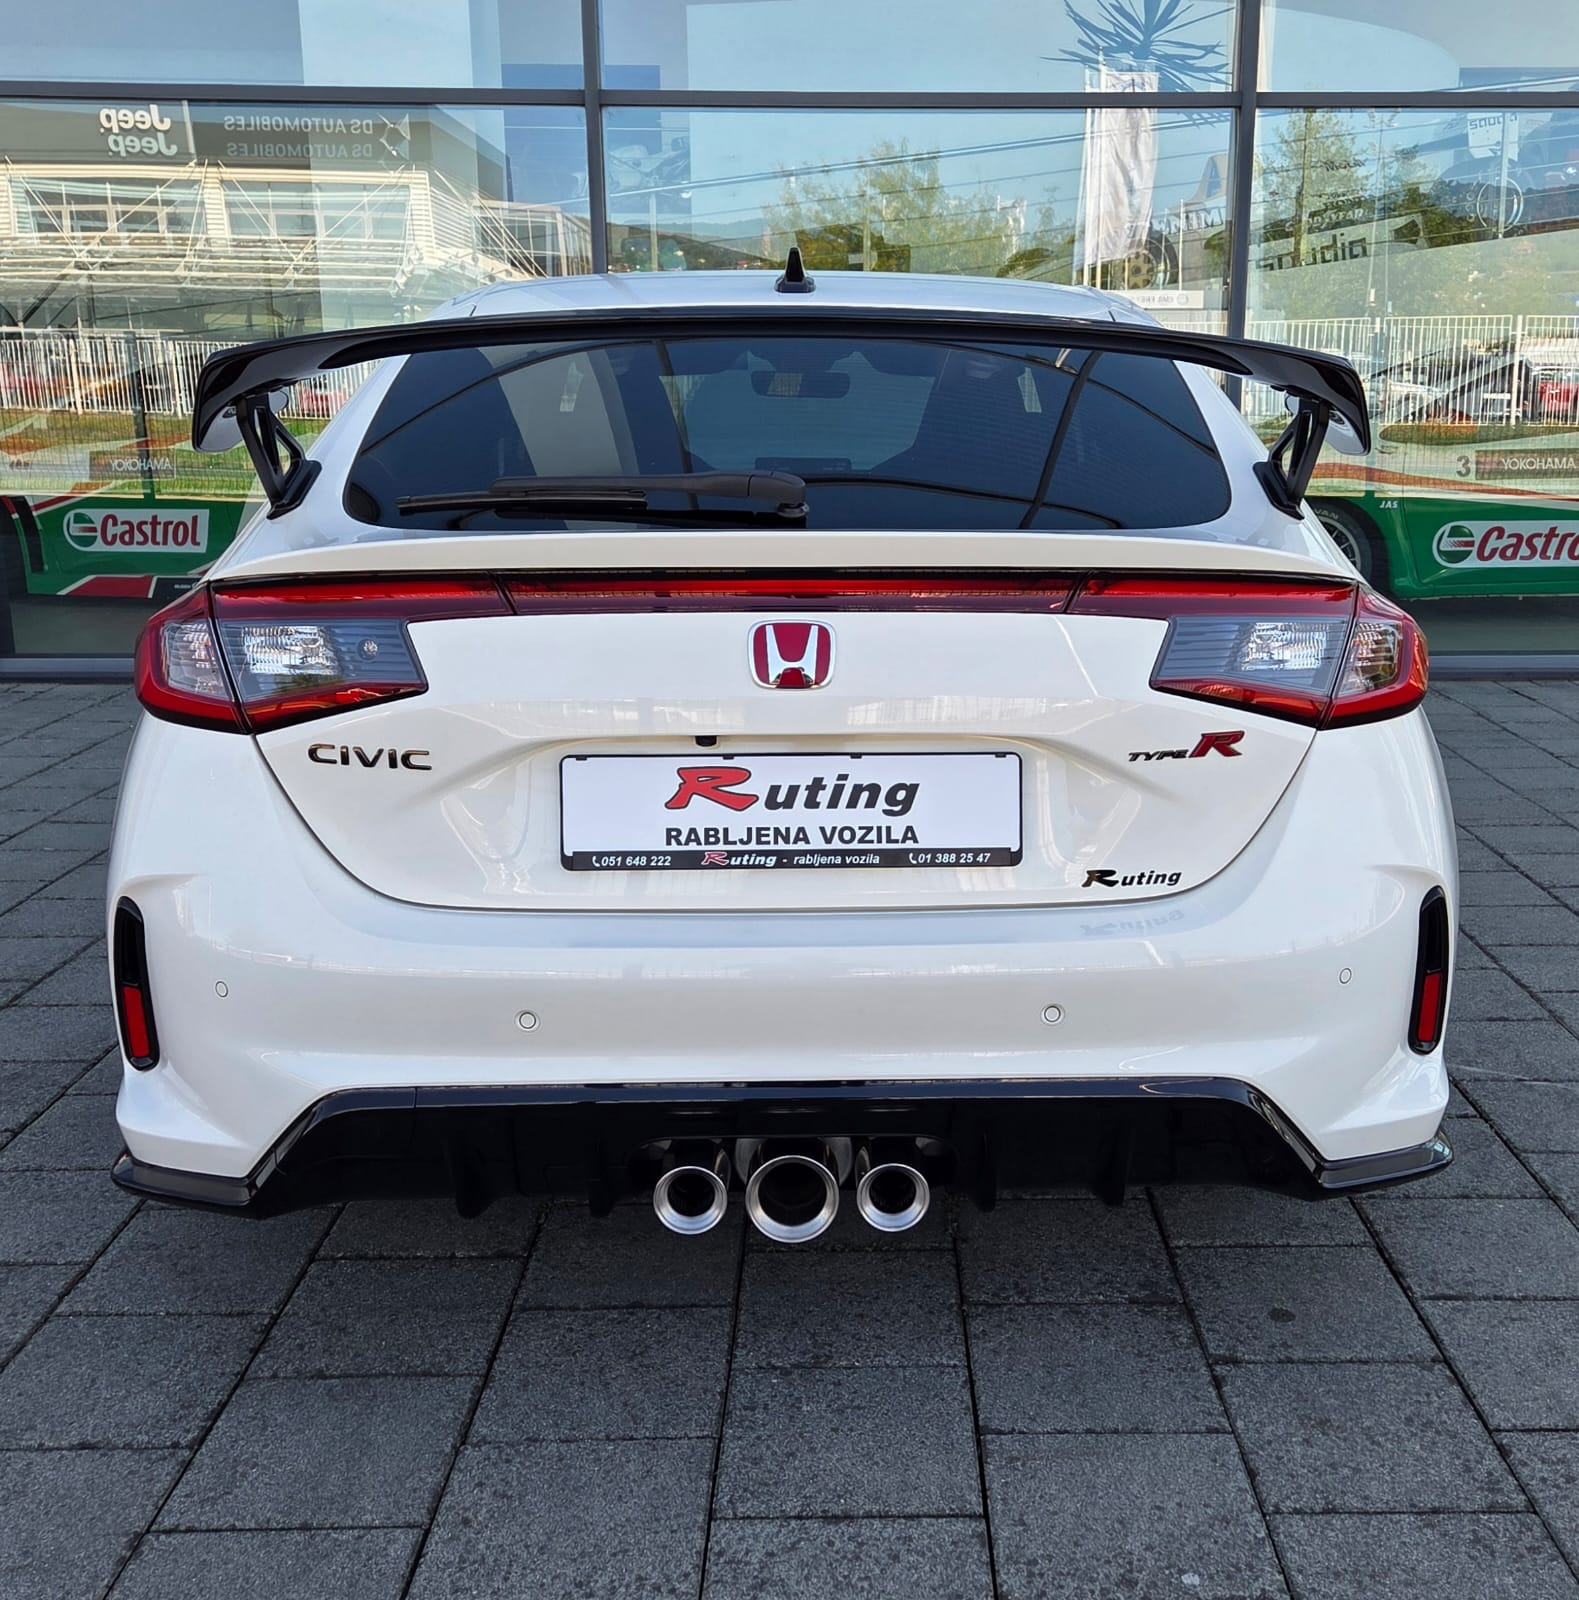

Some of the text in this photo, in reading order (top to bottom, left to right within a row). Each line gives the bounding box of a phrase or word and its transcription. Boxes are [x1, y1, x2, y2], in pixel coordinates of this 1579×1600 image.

[1456, 456, 1471, 477] 3
[1503, 457, 1577, 470] YOKOHAMA
[101, 514, 200, 546] Castrol
[1128, 730, 1245, 762] TYPE R
[308, 743, 433, 771] CIVIC
[665, 766, 920, 817] Ruting
[665, 825, 919, 846] RABLJENA VOZILA
[602, 856, 671, 867] 051 648 222
[701, 851, 777, 867] Ruting
[793, 854, 842, 866] rabljena
[845, 853, 880, 864] vozila
[918, 853, 991, 863] 01 388 25 47
[1081, 870, 1182, 888] Ruting
